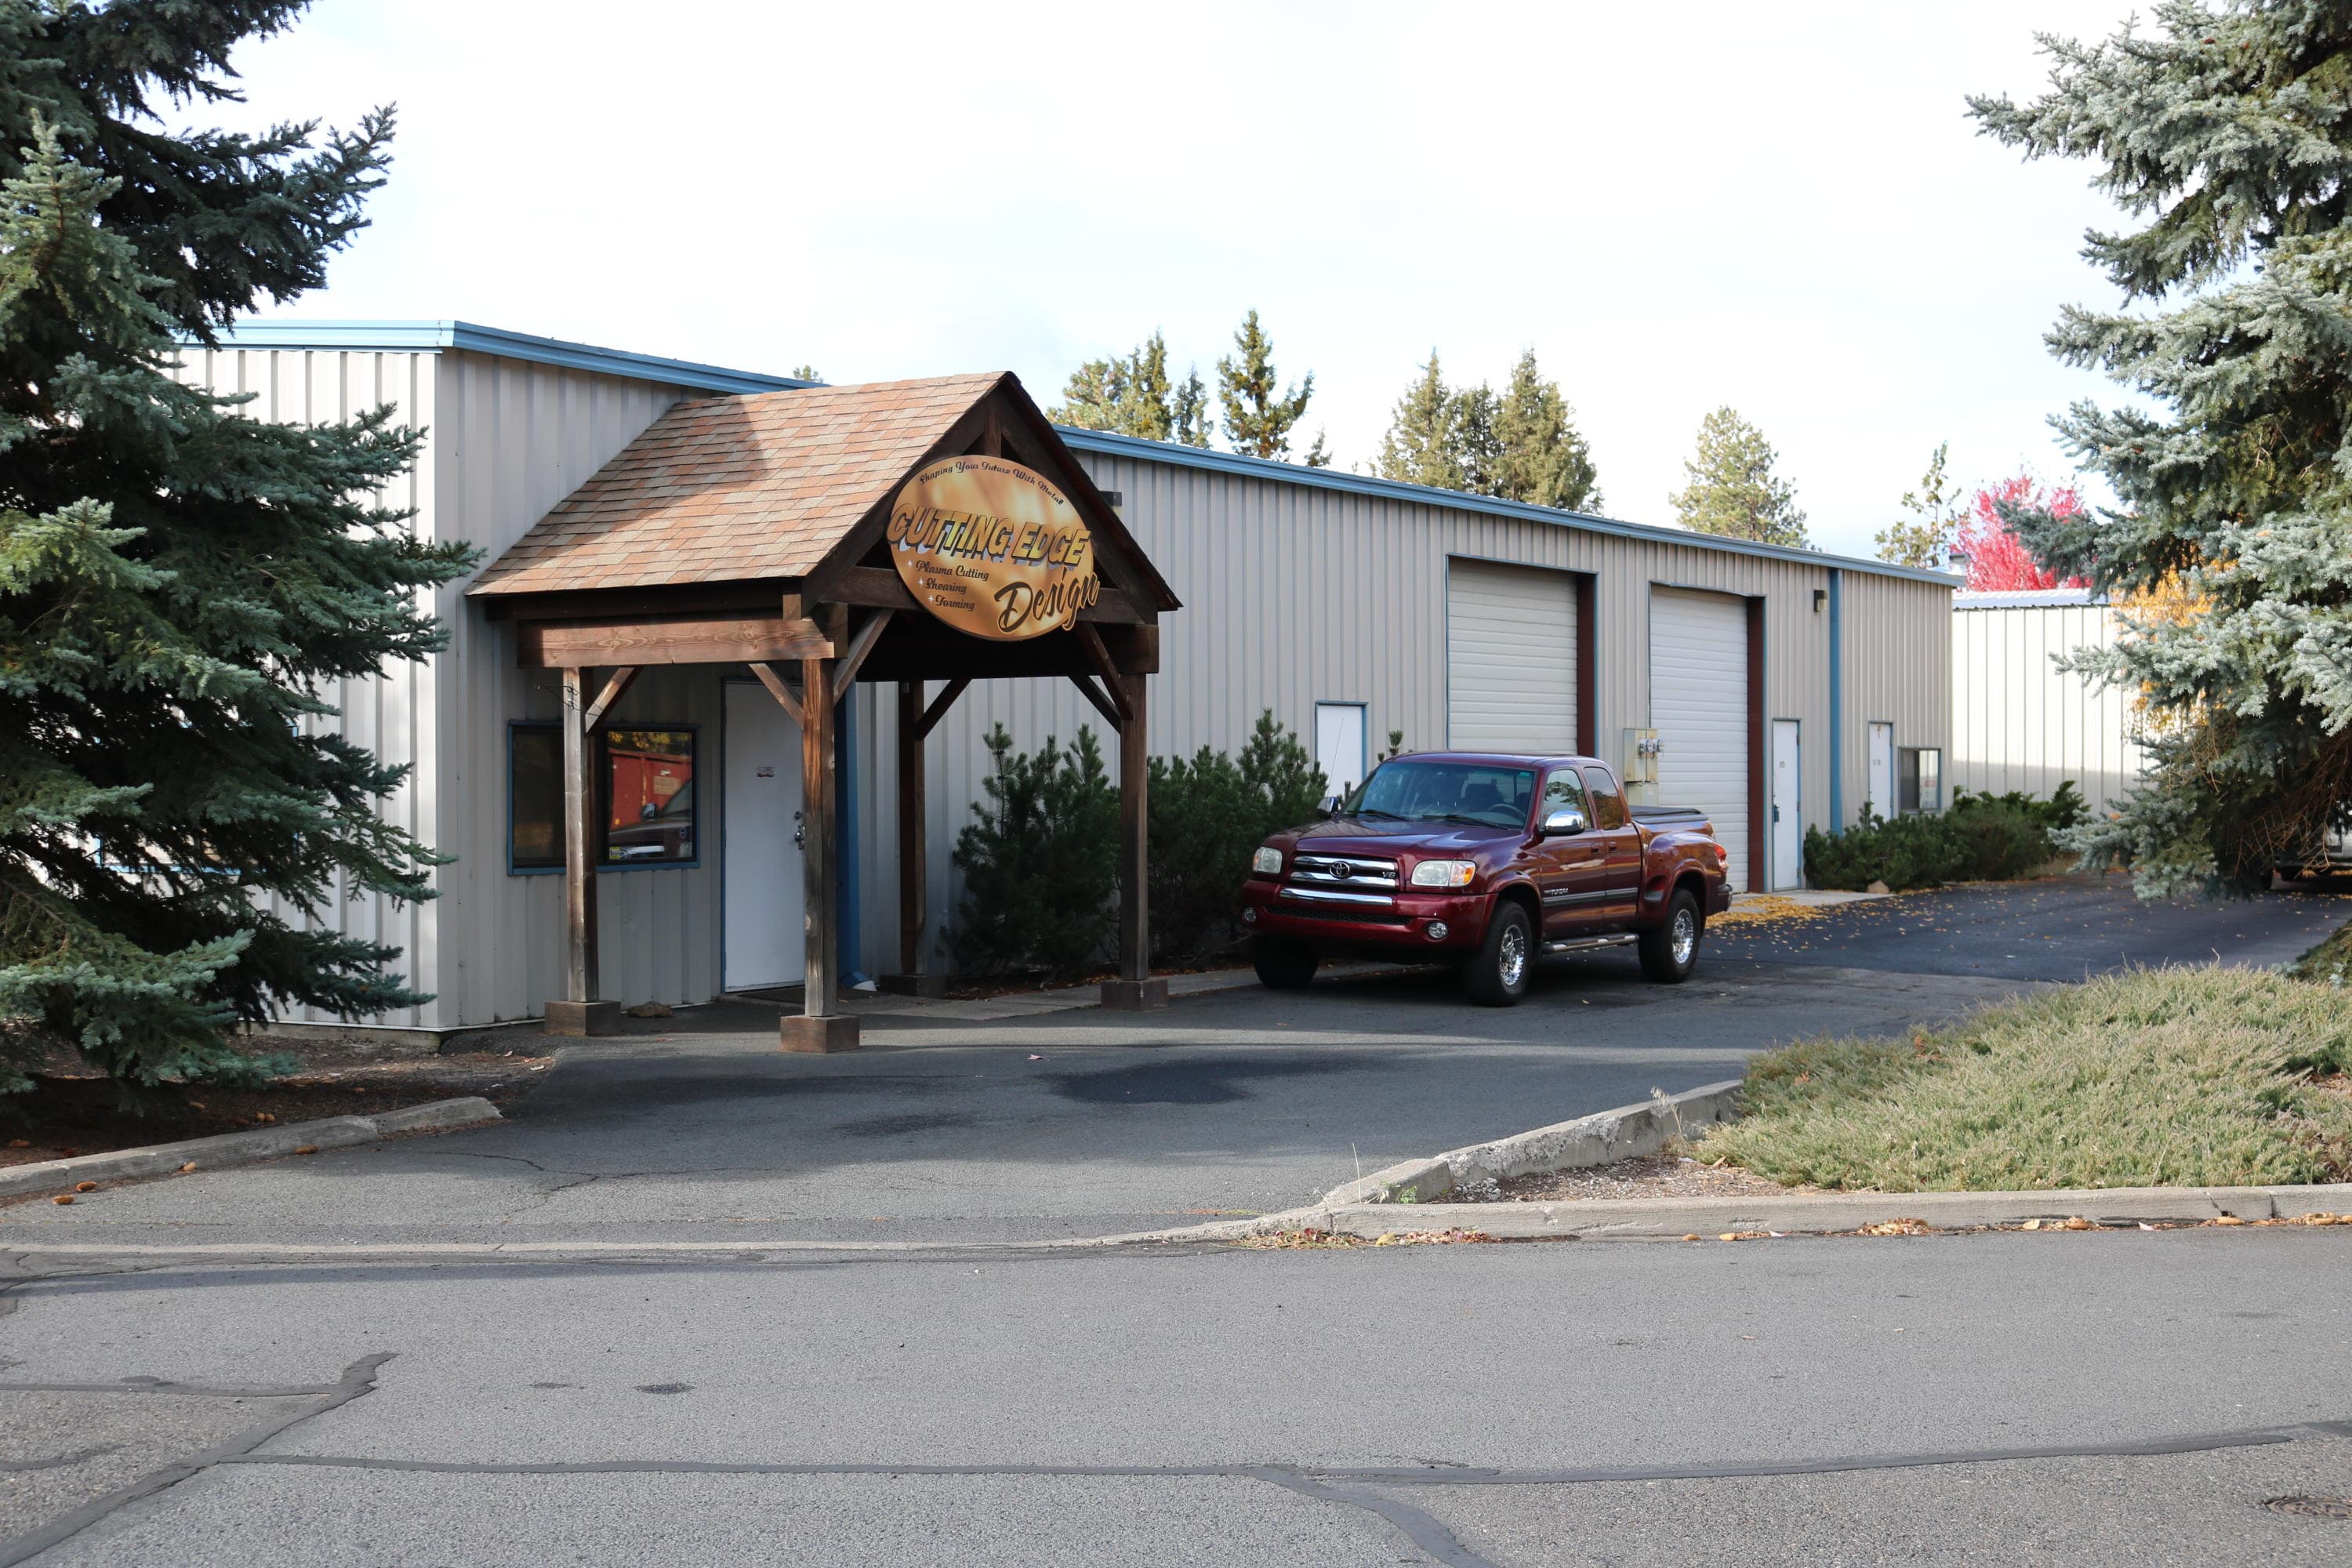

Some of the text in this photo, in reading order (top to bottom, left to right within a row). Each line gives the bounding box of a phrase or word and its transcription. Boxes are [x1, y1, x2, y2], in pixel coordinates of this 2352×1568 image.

[920, 461, 1065, 506] Shaping Your Future With Metal
[887, 503, 1092, 568] CUTTING EDGE
[916, 560, 989, 582] Plasma Cutting
[926, 577, 967, 595] Shearing
[935, 594, 975, 612] Forming
[993, 566, 1101, 633] Design
